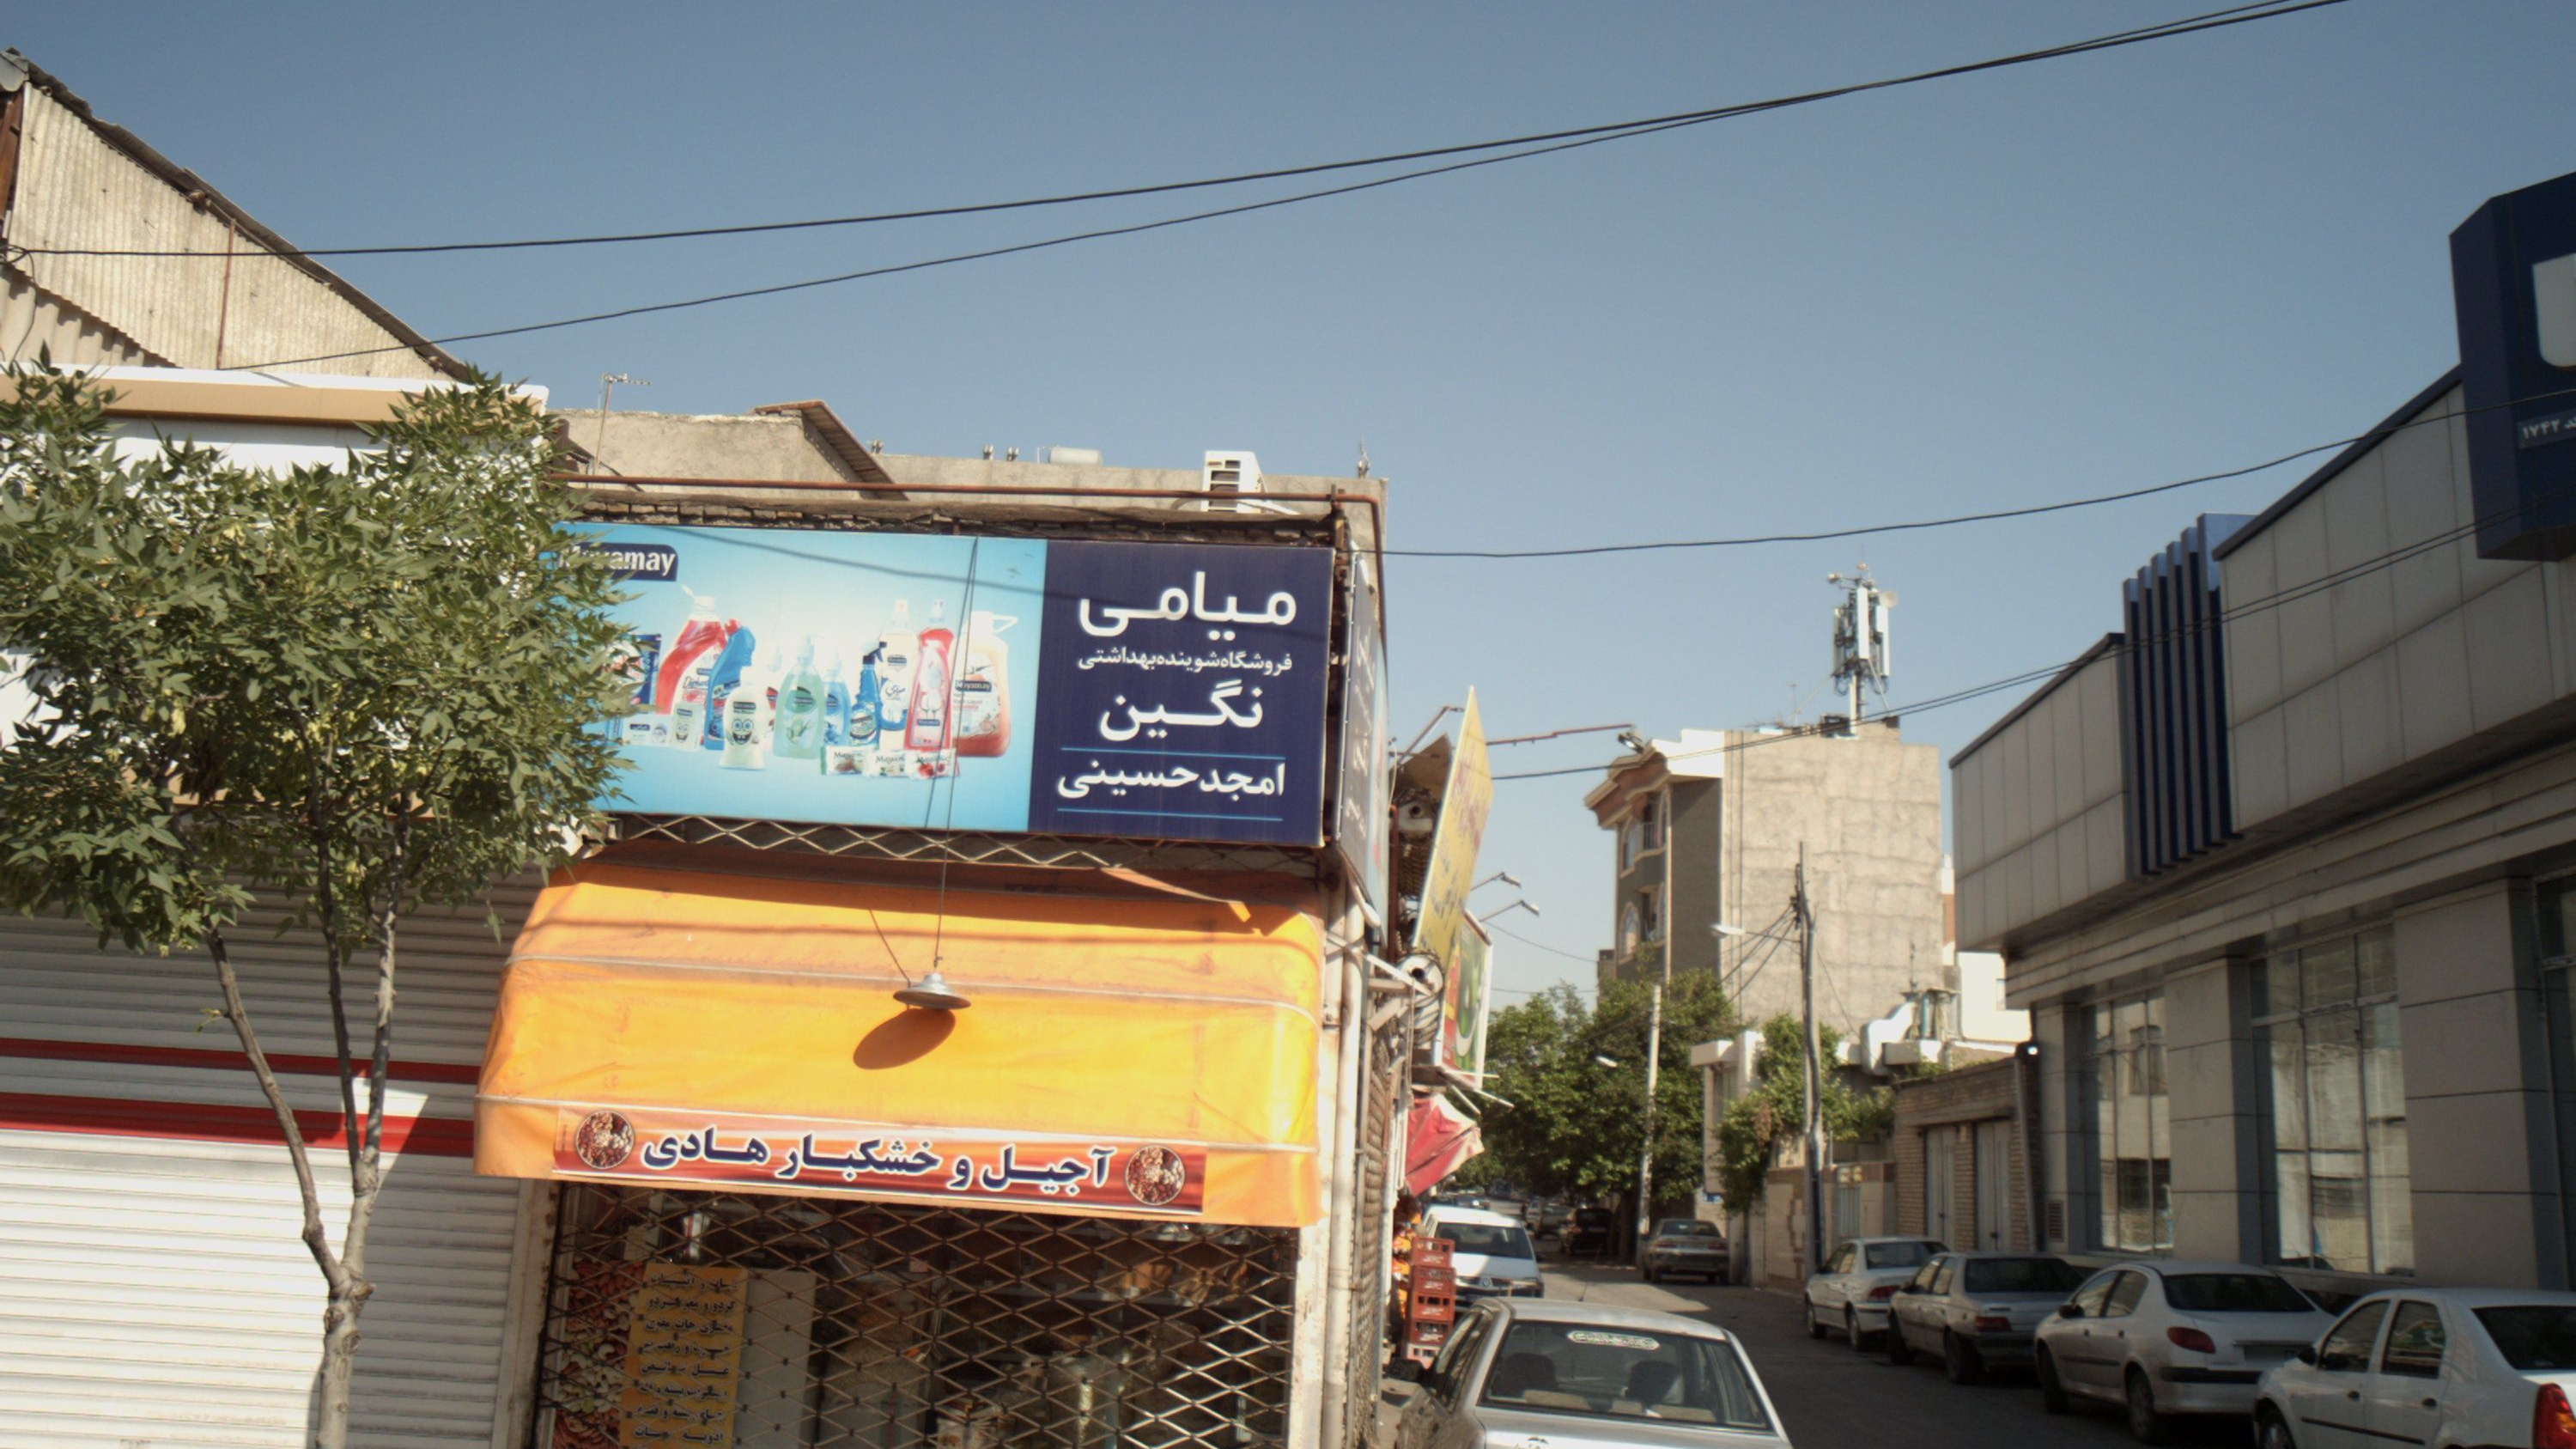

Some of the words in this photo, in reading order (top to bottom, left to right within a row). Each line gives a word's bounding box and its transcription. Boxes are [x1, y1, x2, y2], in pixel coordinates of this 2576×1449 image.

[1078, 570, 1297, 642] میامی
[1078, 646, 1156, 672] بهداشتی
[1157, 650, 1220, 673] شوینده
[1221, 651, 1293, 678] فروشگاه
[1099, 679, 1264, 742] نگین
[1057, 760, 1199, 799] حسینی
[1199, 763, 1286, 801] امجد
[641, 1127, 770, 1169] هادی
[776, 1132, 941, 1179] خشکبار
[948, 1157, 971, 1190] و
[981, 1147, 1115, 1192] آجیل
[633, 1426, 672, 1440] ات
